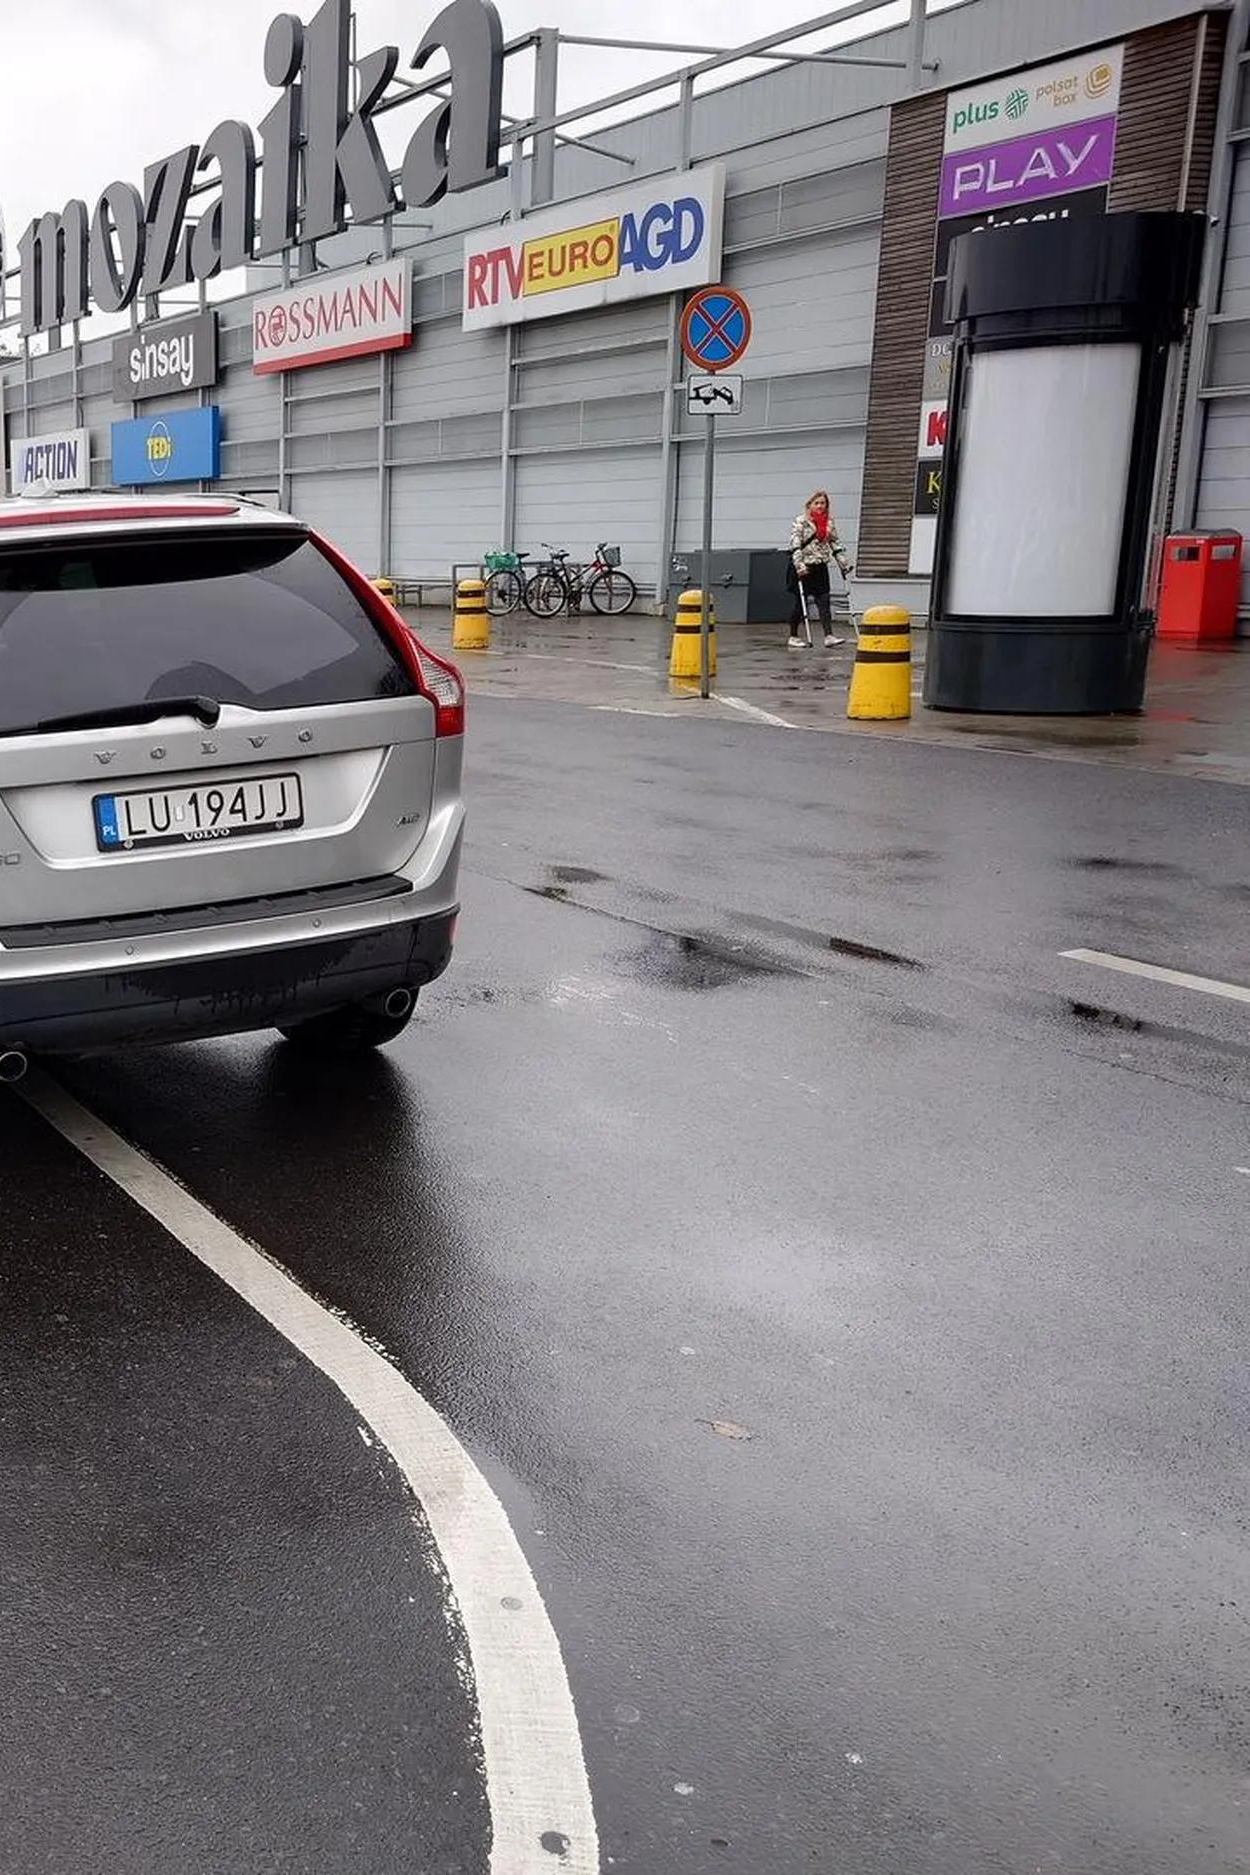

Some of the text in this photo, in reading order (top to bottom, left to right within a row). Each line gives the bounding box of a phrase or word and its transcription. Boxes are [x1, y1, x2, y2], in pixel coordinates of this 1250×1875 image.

[1036, 76, 1078, 100] polsat
[1053, 93, 1077, 108] box
[953, 101, 999, 134] plus
[18, 0, 507, 338] mozaika
[953, 134, 1098, 200] PLAY
[468, 197, 704, 309] RTV EURO AGD
[255, 272, 402, 350] ROSSMANN
[129, 334, 194, 386] sinsay
[24, 440, 78, 483] ACTION
[94, 729, 313, 765] VOLVO
[125, 782, 288, 836] LU 194JJ
[103, 826, 116, 837] PL
[183, 828, 230, 842] VOLVO
